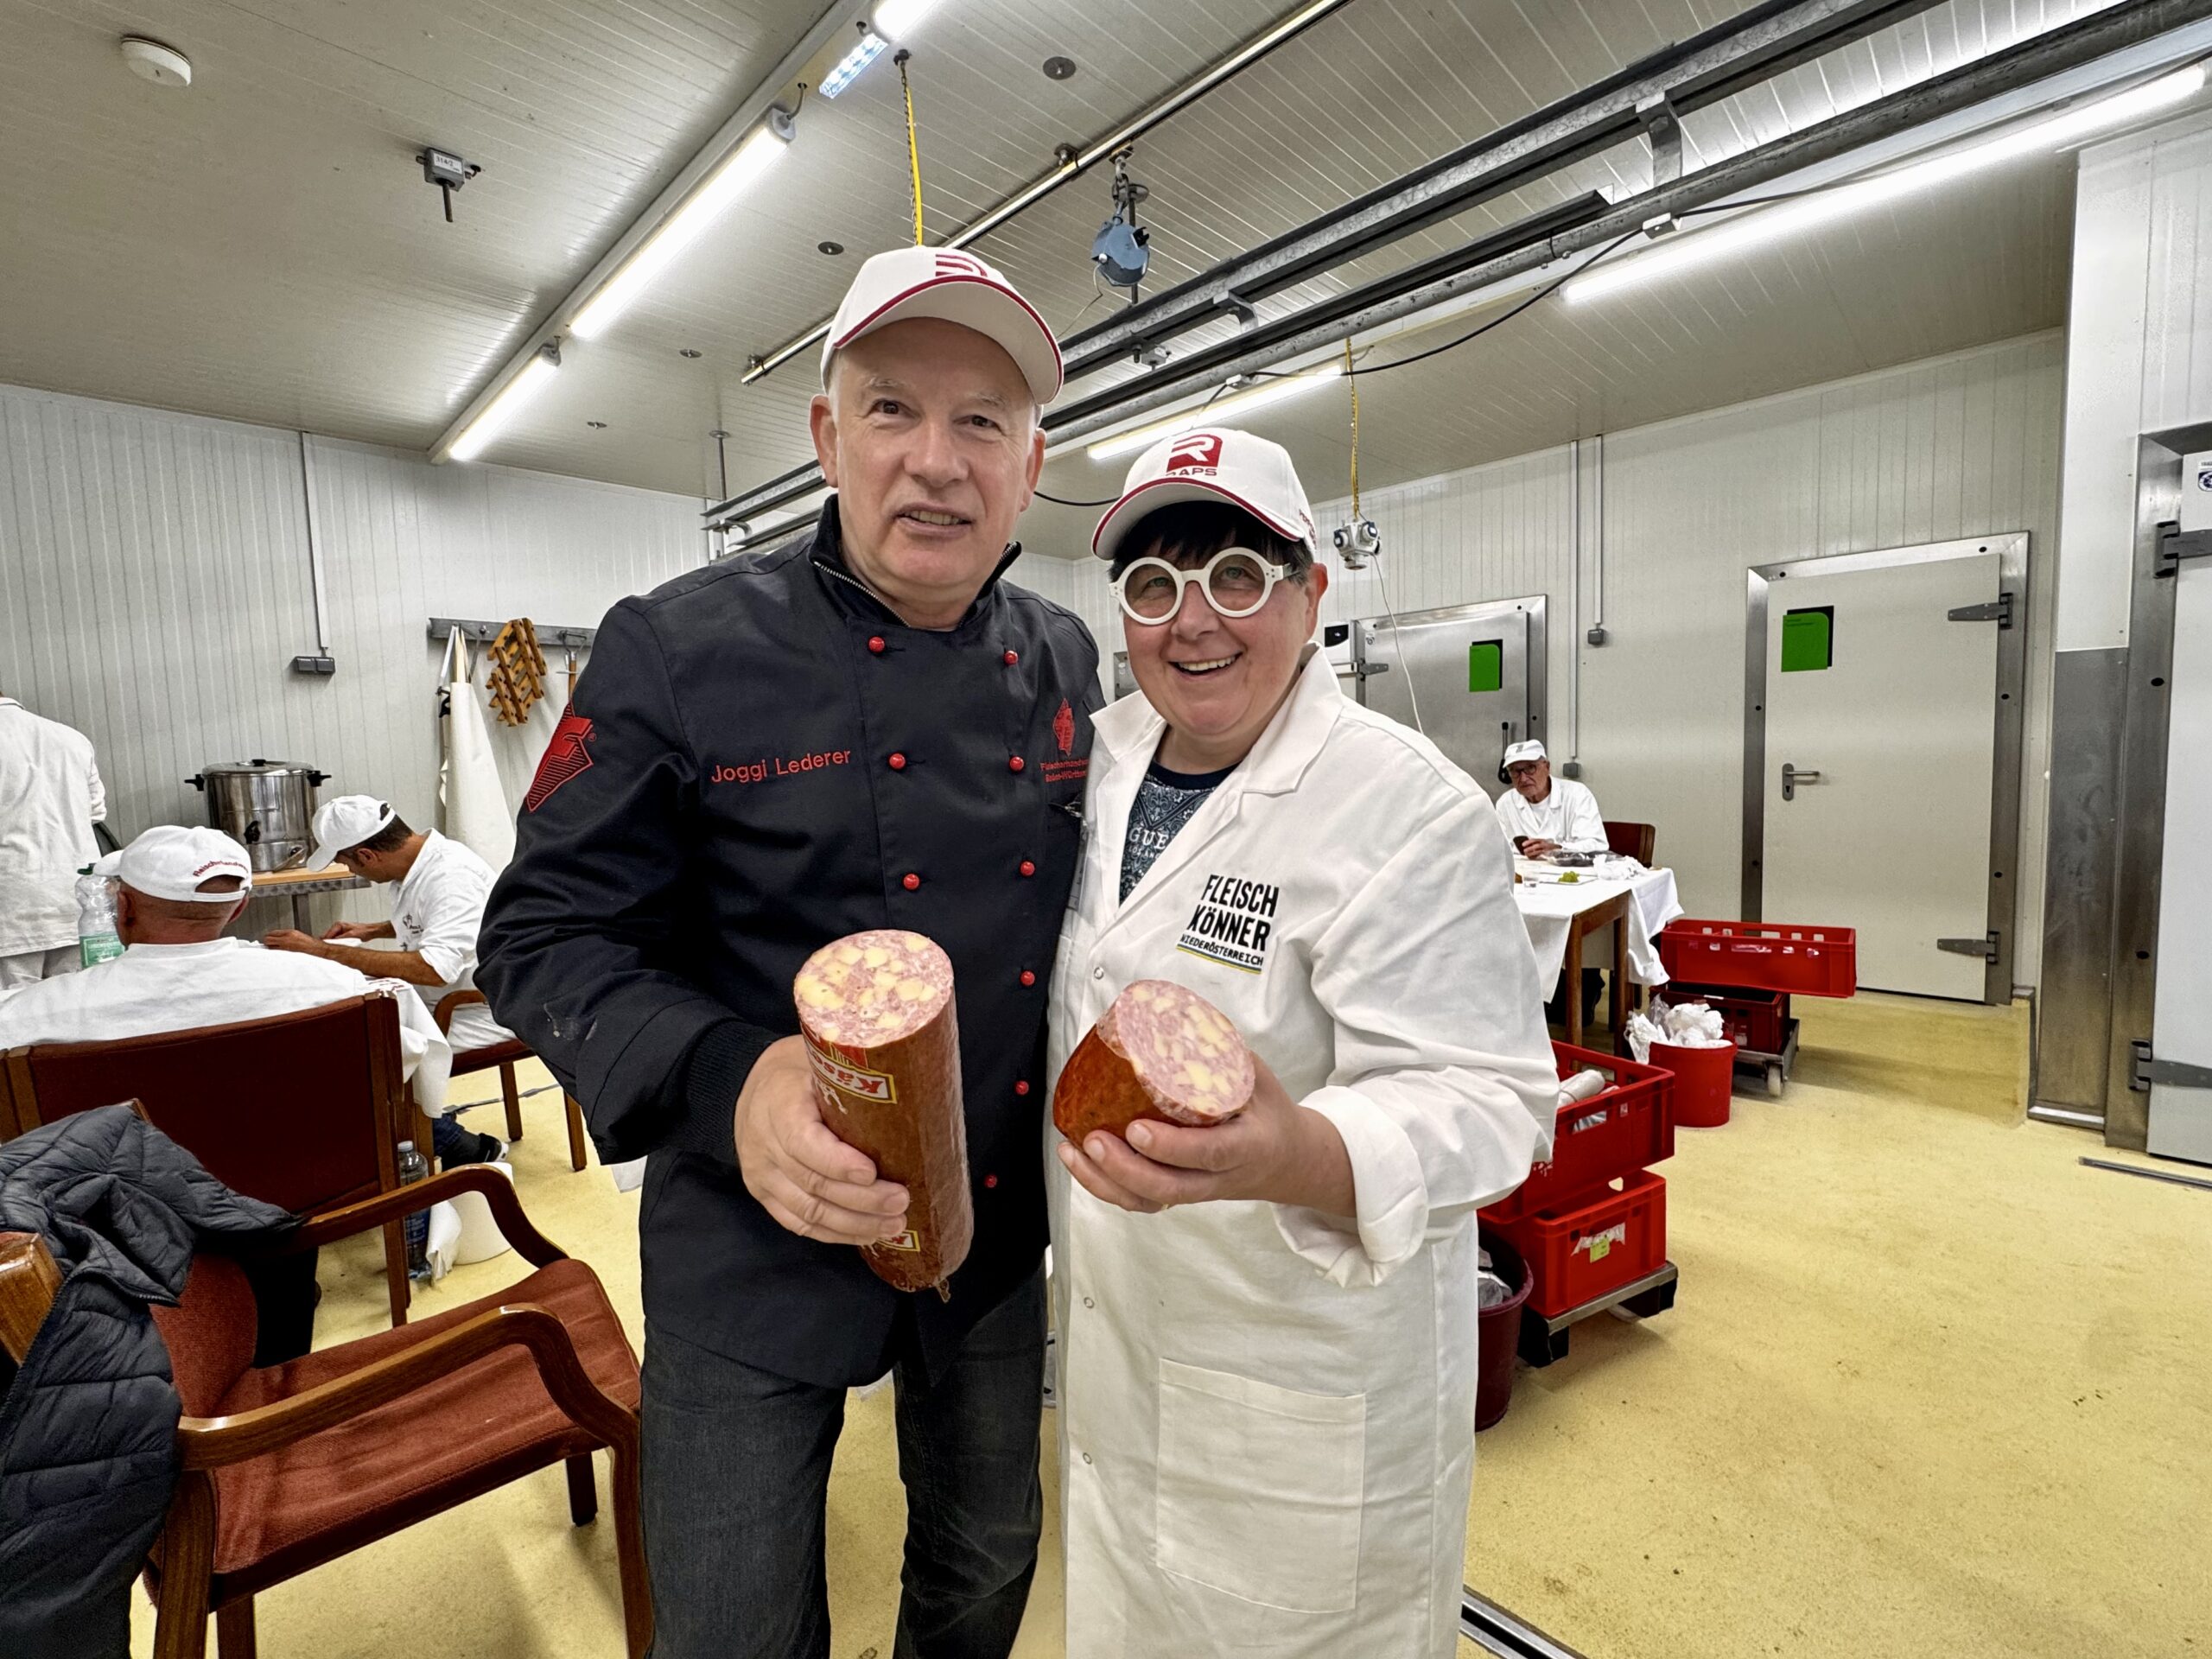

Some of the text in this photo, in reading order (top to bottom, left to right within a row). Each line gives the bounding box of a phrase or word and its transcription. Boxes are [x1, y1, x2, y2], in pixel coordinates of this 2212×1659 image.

[711, 749, 851, 783] Joggi Lederer
[1129, 827, 1169, 849] GUE
[1200, 874, 1280, 918] FLEISCH
[1186, 904, 1271, 952] KÖNNER
[1179, 933, 1264, 967] NIEDERÖSTERREICH
